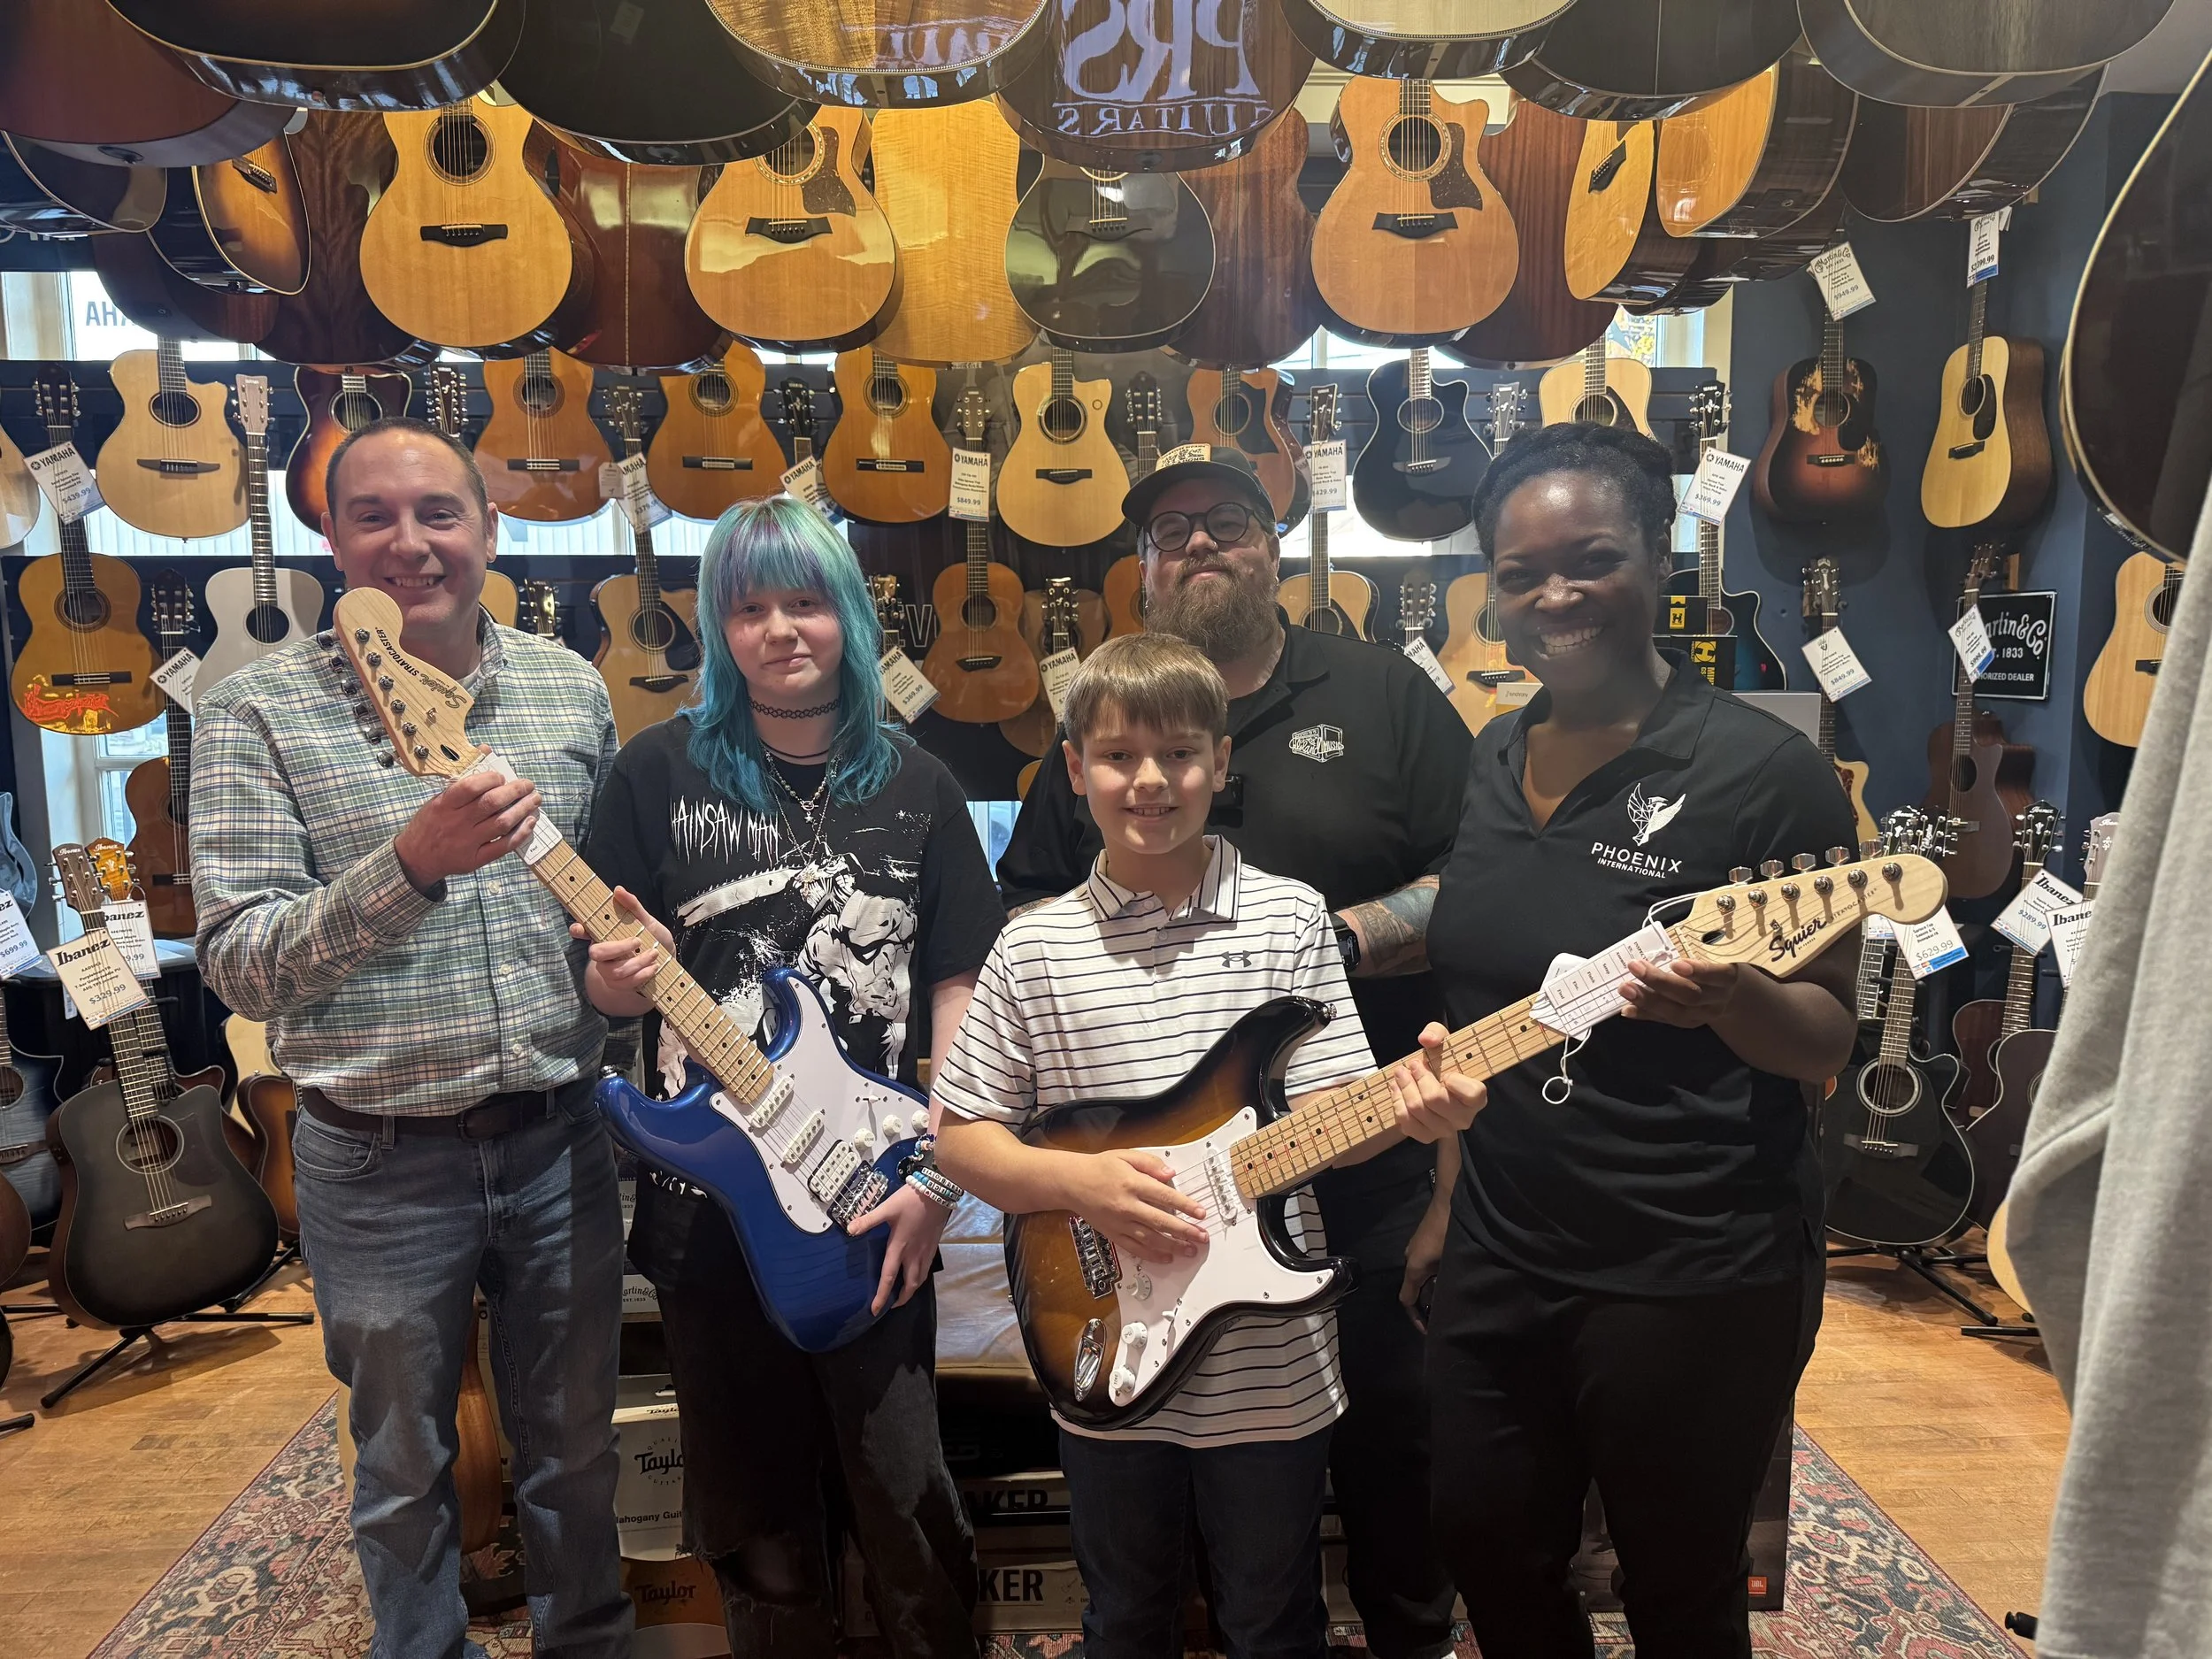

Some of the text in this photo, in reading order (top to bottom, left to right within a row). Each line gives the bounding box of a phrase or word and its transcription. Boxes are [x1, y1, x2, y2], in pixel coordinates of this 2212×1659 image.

[39, 448, 75, 467] YAMAHA
[961, 454, 988, 467] YAMAHA
[1313, 445, 1342, 458] YAMAHA
[621, 458, 646, 475] MAHA
[790, 461, 815, 480] YAMAHA
[1714, 455, 1745, 473] YAMAHA
[62, 488, 91, 503] $439.99
[1985, 611, 2047, 659] artin&Co.
[1406, 641, 1425, 658] MAHA
[2002, 647, 2024, 658] 1833
[165, 652, 194, 678] YAMAHA
[376, 628, 467, 709] Squier STRATOCASTER
[1048, 653, 1077, 670] YAMAHA
[670, 795, 782, 869] HAINSAW MAN
[1591, 841, 1683, 873] PHOENIX
[1597, 857, 1666, 879] INTERNATIONAL
[104, 910, 145, 922] banez
[2018, 909, 2047, 930] $289.99
[2053, 909, 2092, 927] Ibane
[0, 940, 28, 957] $699.99
[1768, 918, 1827, 963] Squier
[55, 939, 111, 967] Ibanez
[1916, 940, 1954, 962] $629.99
[88, 984, 127, 1004] $329.99
[648, 1436, 678, 1451] QUALI
[634, 1448, 685, 1475] Taylo
[649, 1475, 682, 1486] GUITAR
[663, 1510, 683, 1520] Guit
[634, 1580, 696, 1605] Taylor
[979, 1569, 1044, 1601] KER
